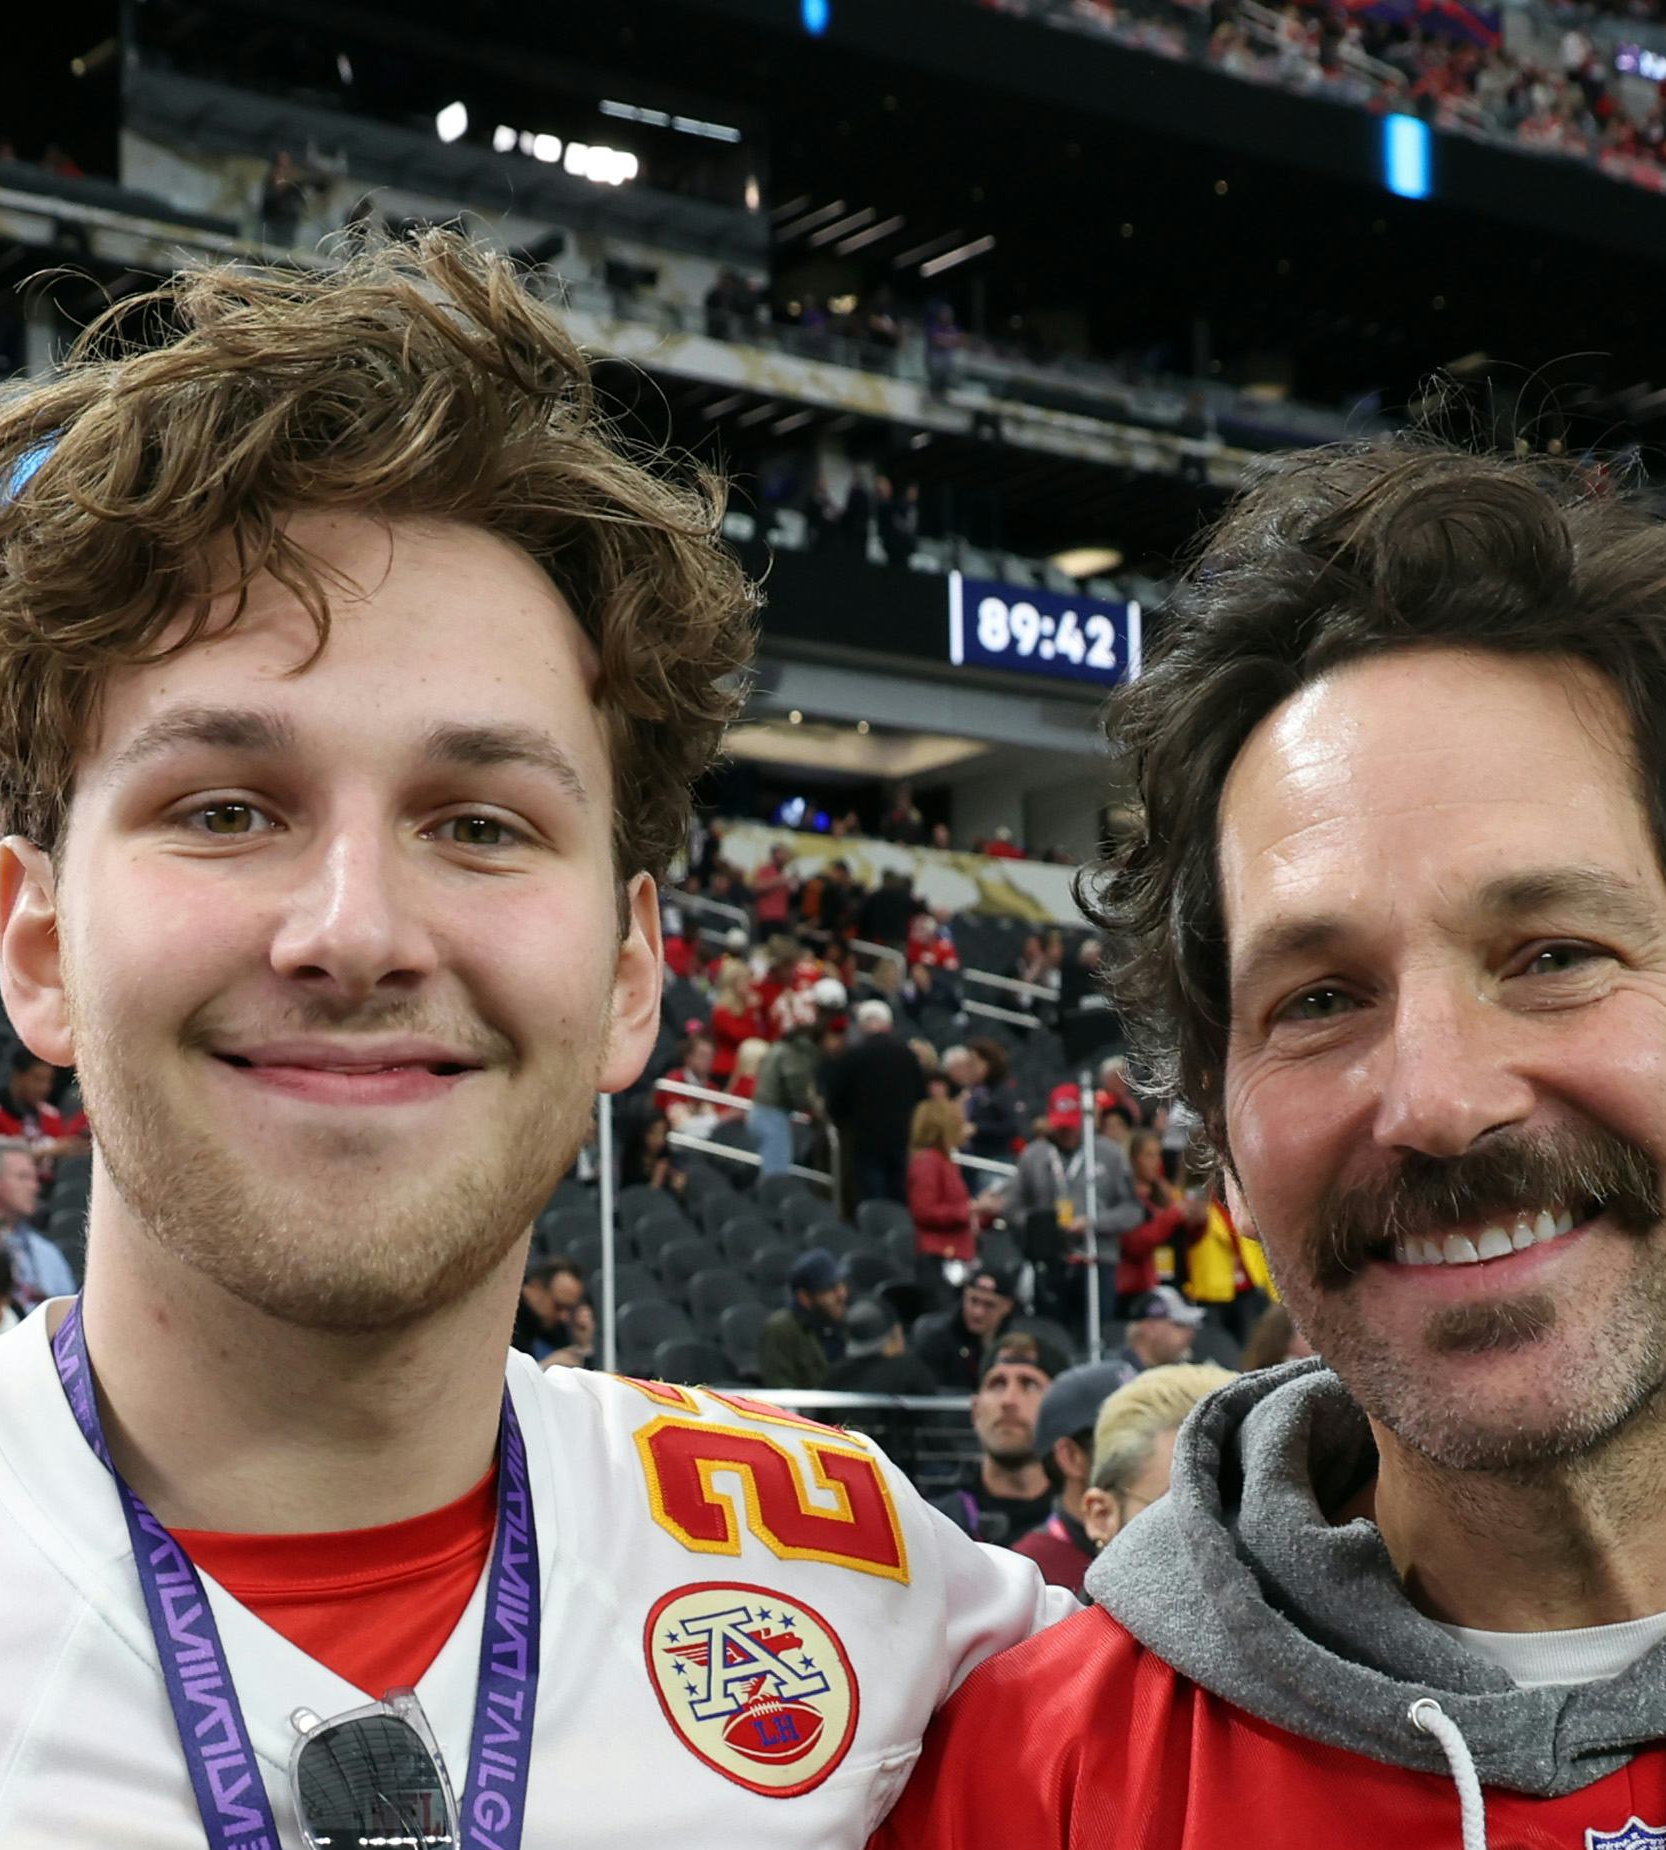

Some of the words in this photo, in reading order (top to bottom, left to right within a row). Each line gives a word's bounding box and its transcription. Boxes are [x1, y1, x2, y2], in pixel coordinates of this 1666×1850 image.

[977, 597, 1116, 670] 89:42
[613, 1374, 911, 1587] 2
[753, 1715, 800, 1747] LH
